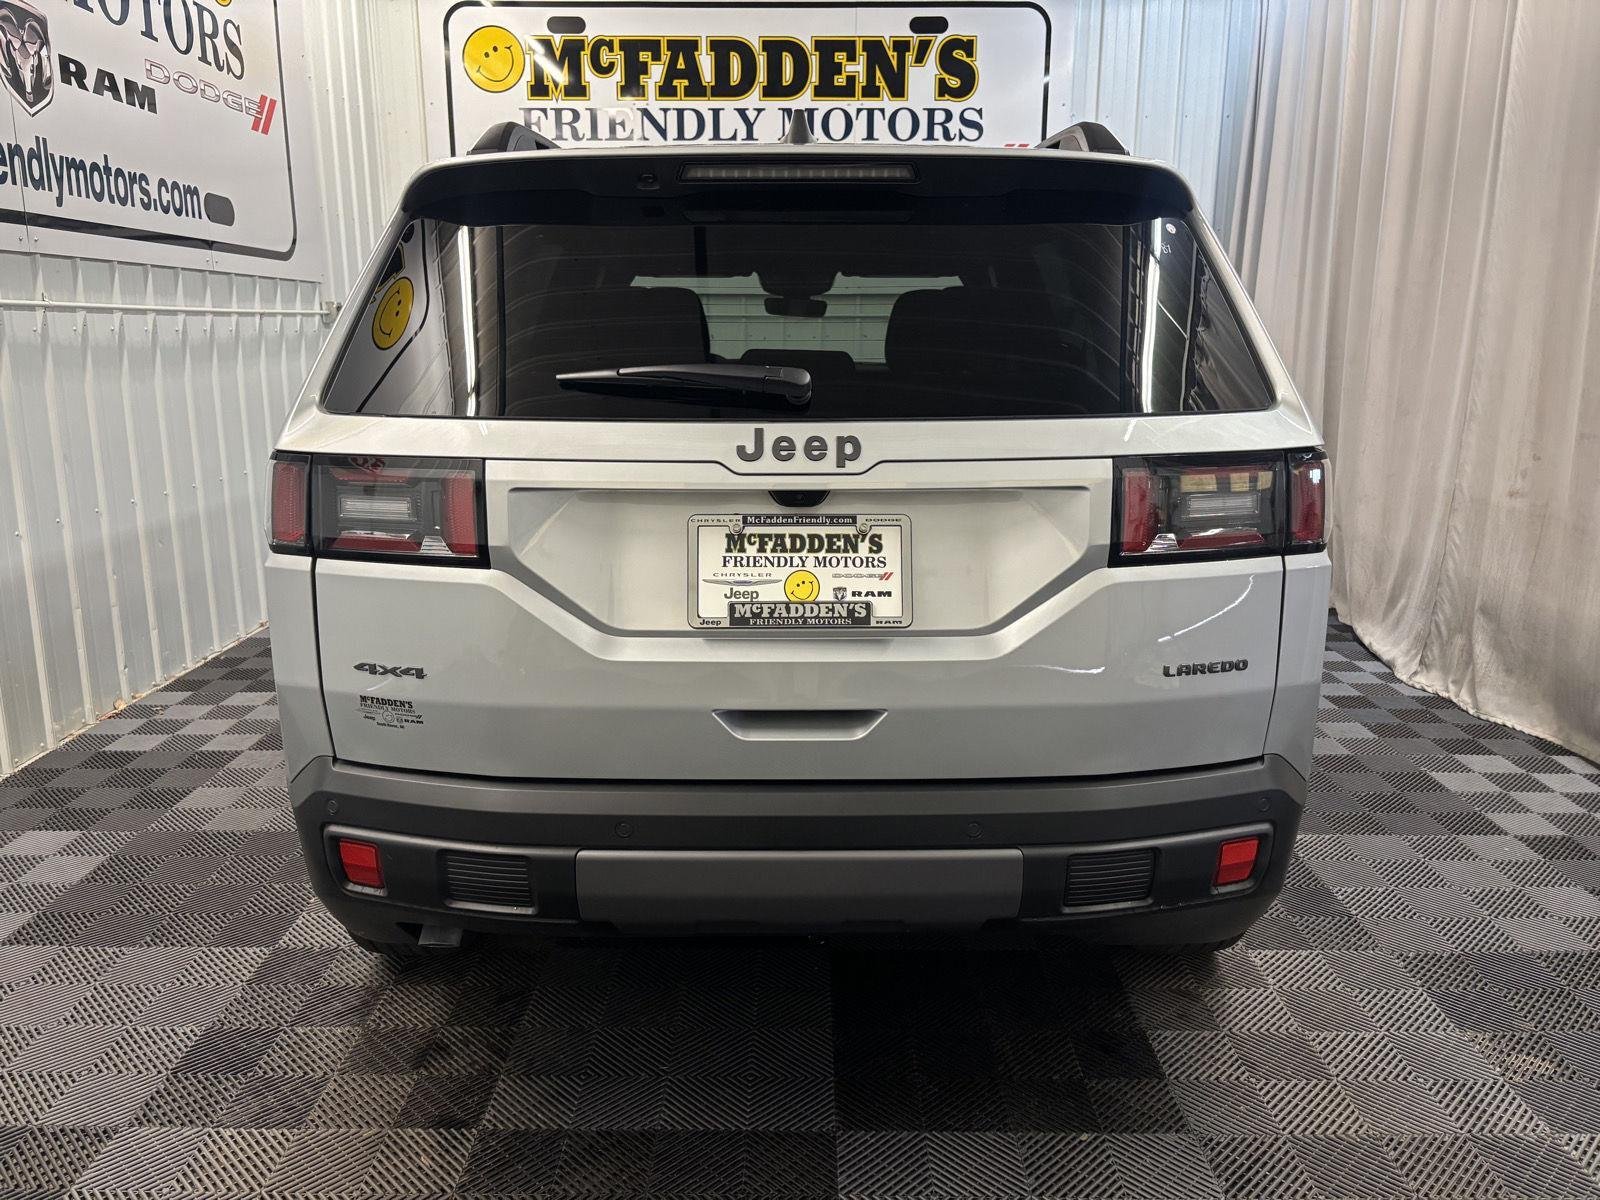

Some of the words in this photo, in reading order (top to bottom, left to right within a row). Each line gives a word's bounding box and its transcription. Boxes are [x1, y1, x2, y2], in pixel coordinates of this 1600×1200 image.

[66, 0, 245, 80] TORS
[58, 53, 158, 115] RAM
[144, 58, 264, 121] DODGE
[519, 107, 766, 142] FRIENDLY
[736, 427, 862, 468] Jeep
[747, 515, 853, 526] McFaddenFriendly.com
[721, 555, 808, 568] FRIENDLY
[812, 555, 887, 569] MOTORS
[723, 587, 760, 601] Jeep
[851, 590, 893, 598] RAM
[749, 618, 804, 626] FRIENDLY
[807, 618, 852, 626] MOTORS
[1162, 659, 1249, 678] LAREDO
